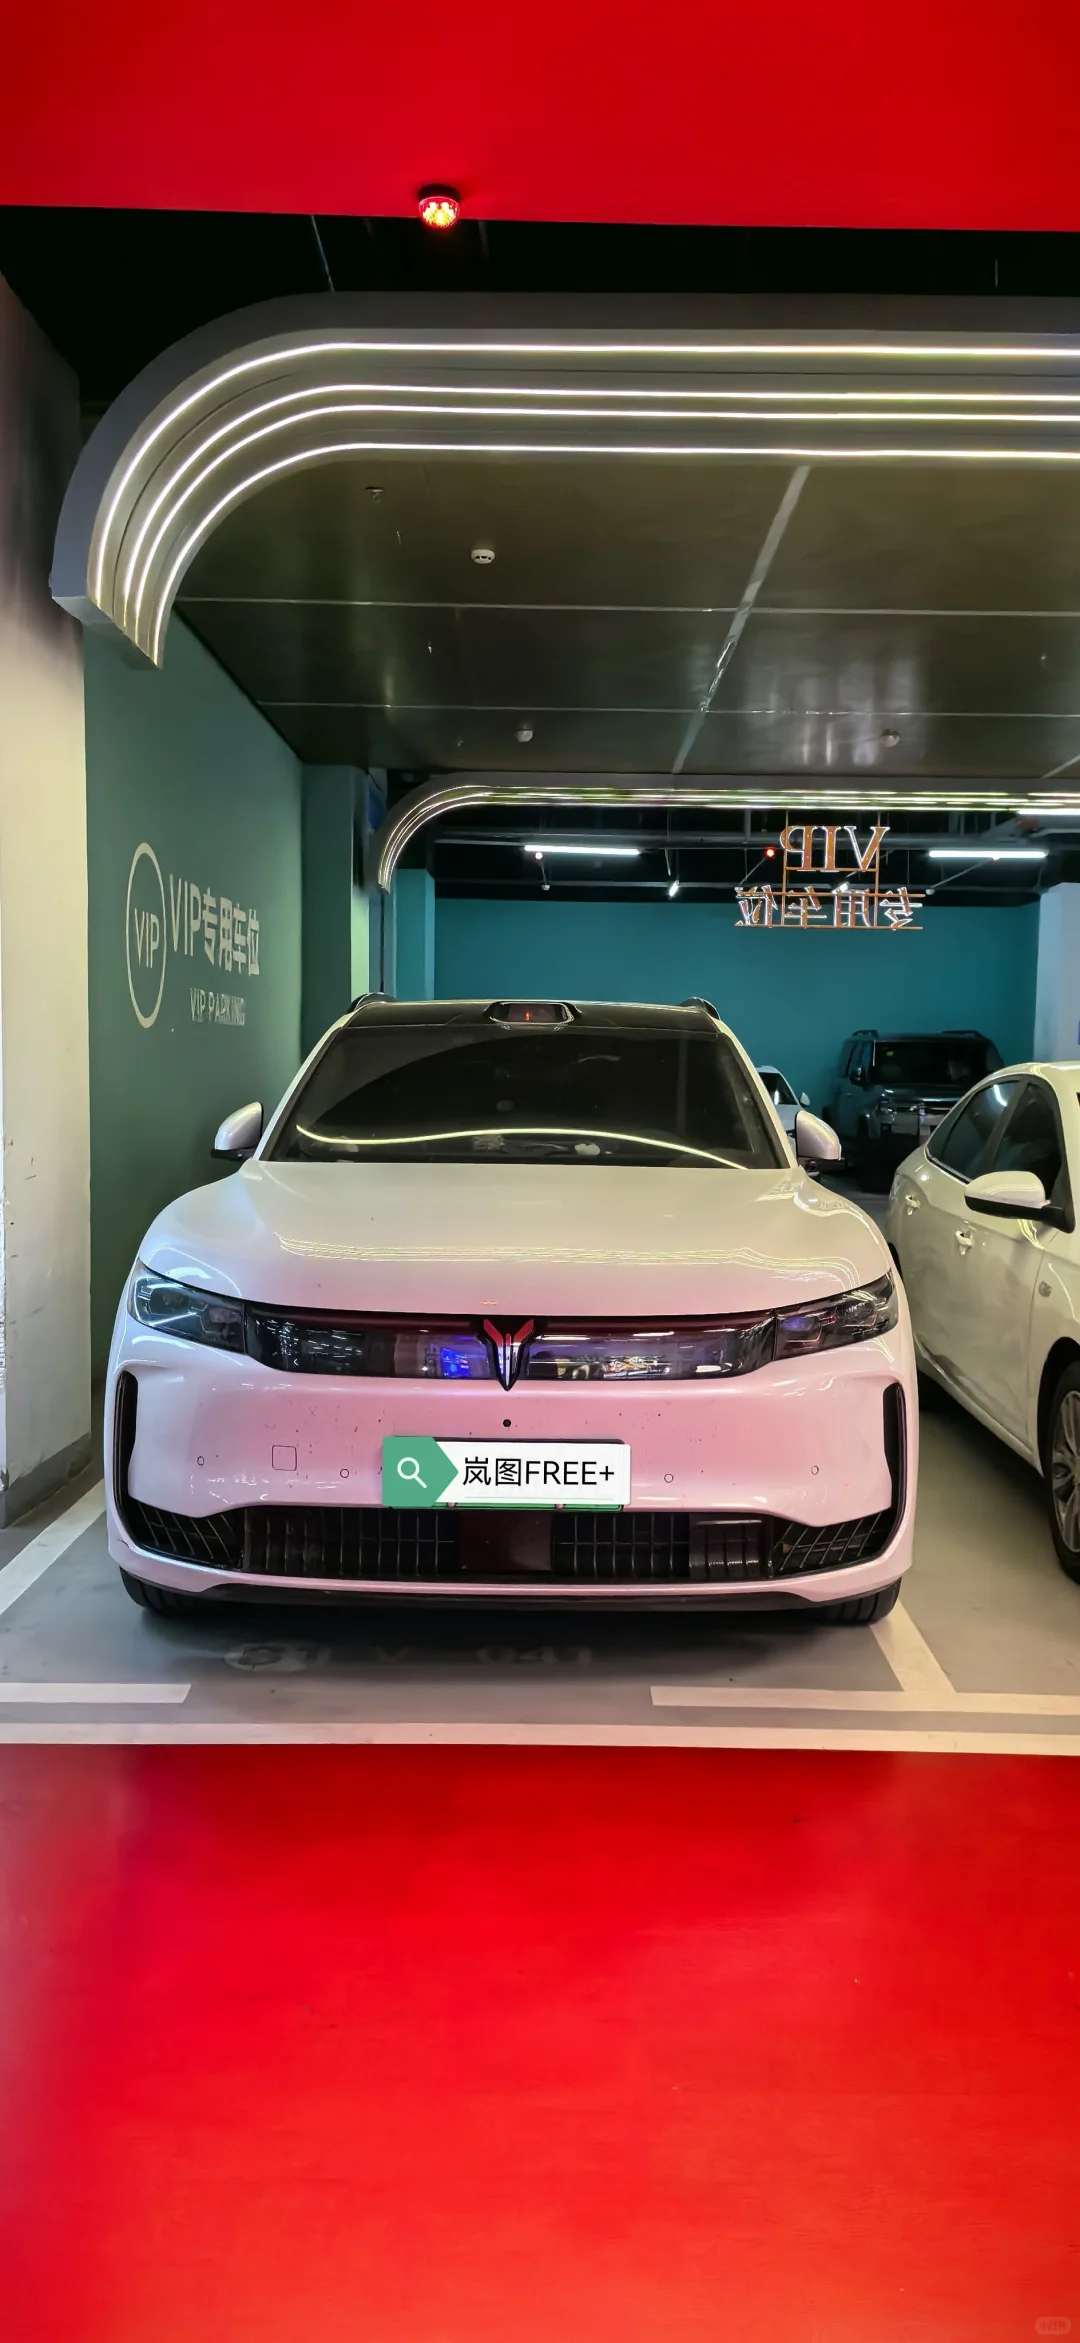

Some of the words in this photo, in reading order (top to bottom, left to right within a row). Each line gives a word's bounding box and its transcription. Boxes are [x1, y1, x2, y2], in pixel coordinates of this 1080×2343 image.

[134, 907, 160, 969] VIP
[169, 873, 260, 977] VIP专用车位
[189, 987, 206, 1023] VIP
[208, 991, 246, 1027] PARKING
